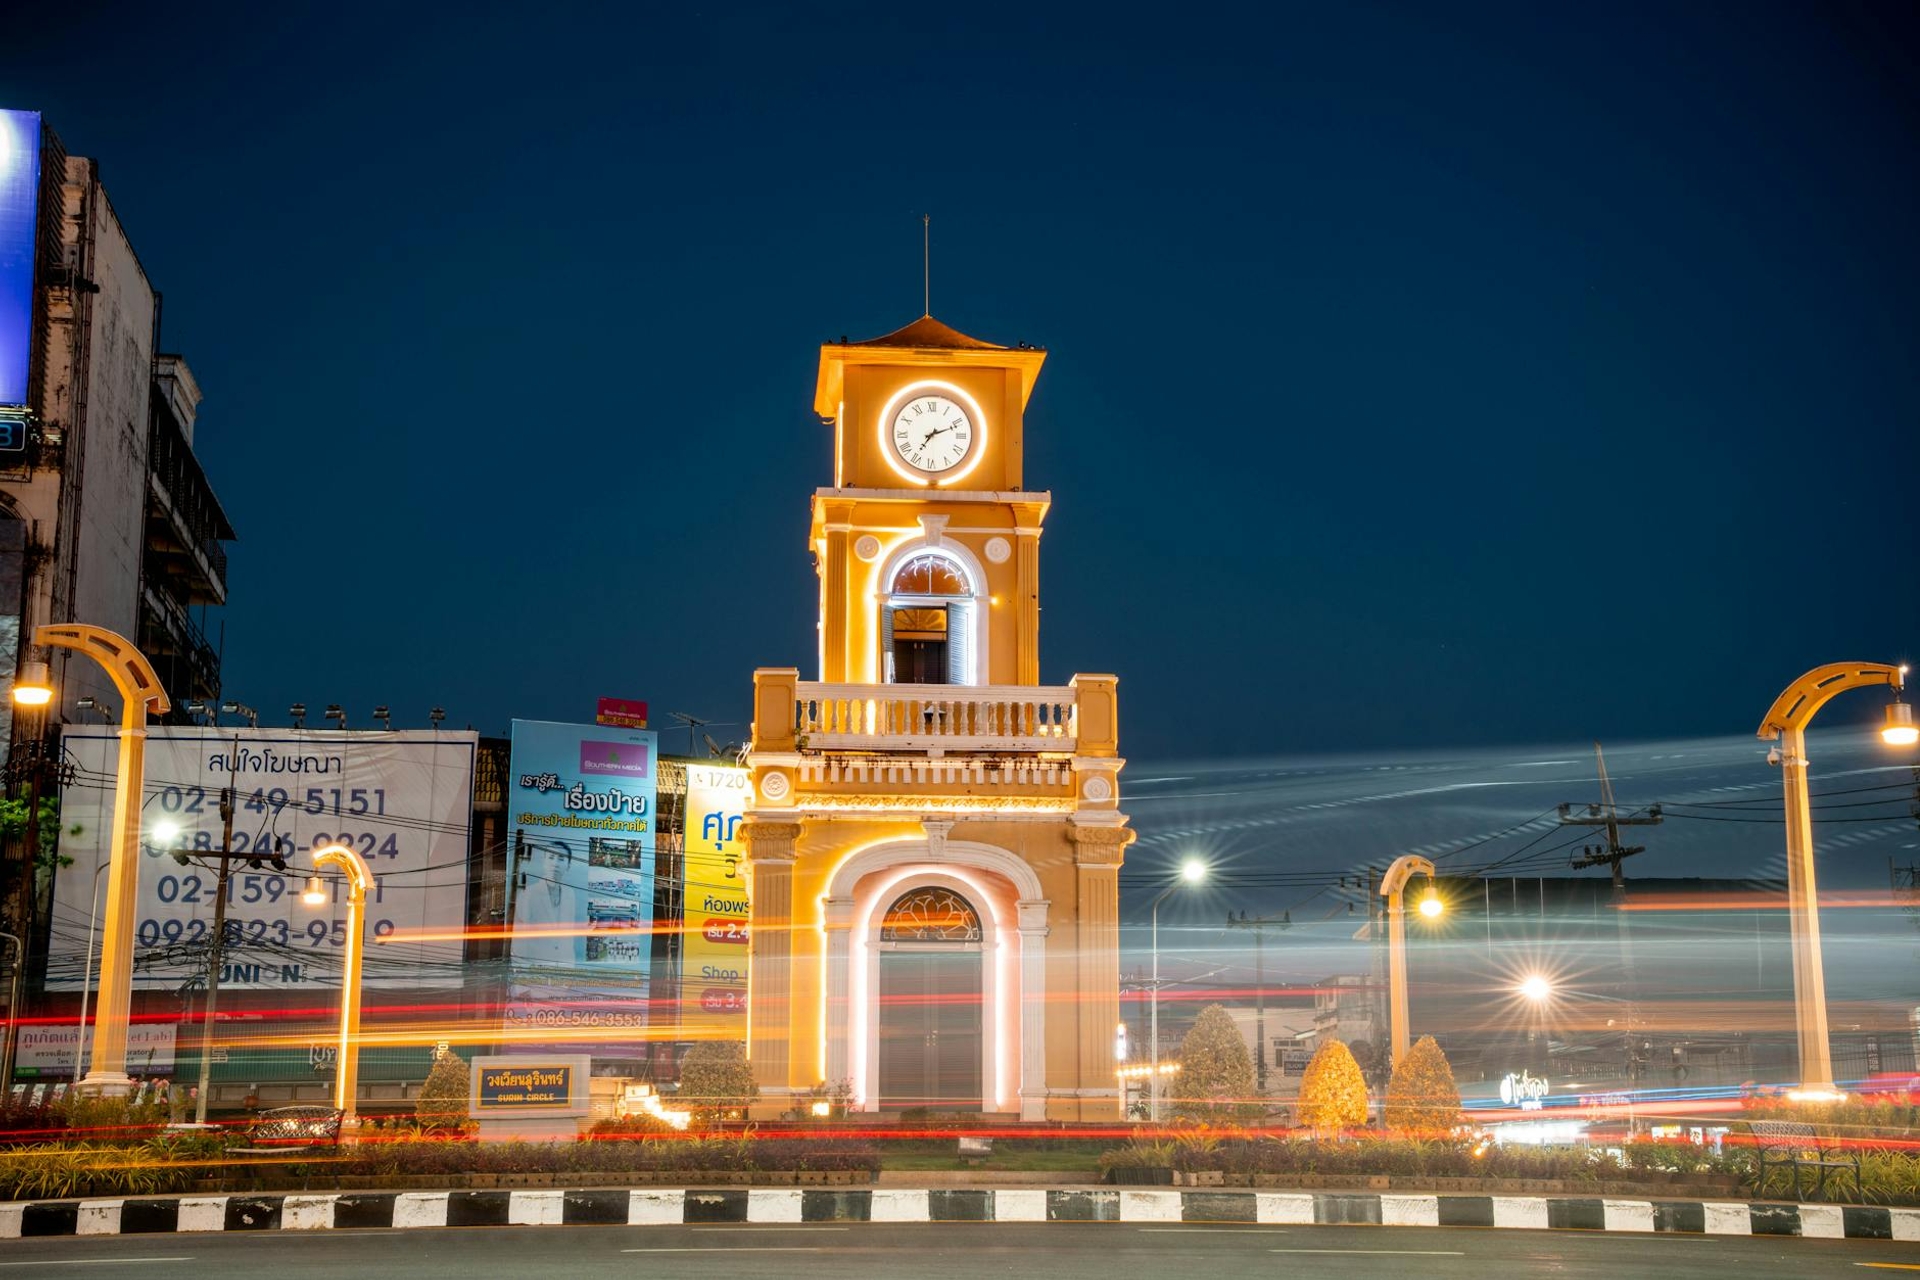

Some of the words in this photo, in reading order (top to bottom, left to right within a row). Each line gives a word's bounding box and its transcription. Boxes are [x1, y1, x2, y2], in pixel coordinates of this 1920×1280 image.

[209, 748, 341, 774] สนใจโฆษณา
[708, 771, 745, 789] 1720
[161, 786, 386, 816] 02-149-5151
[564, 782, 646, 814] เรื่องป้าย
[157, 875, 383, 904] 02-159-11
[702, 966, 739, 984] Shop
[487, 1069, 565, 1092] วงเวียนสุรินทร์
[526, 1093, 555, 1102] CIRCLE
